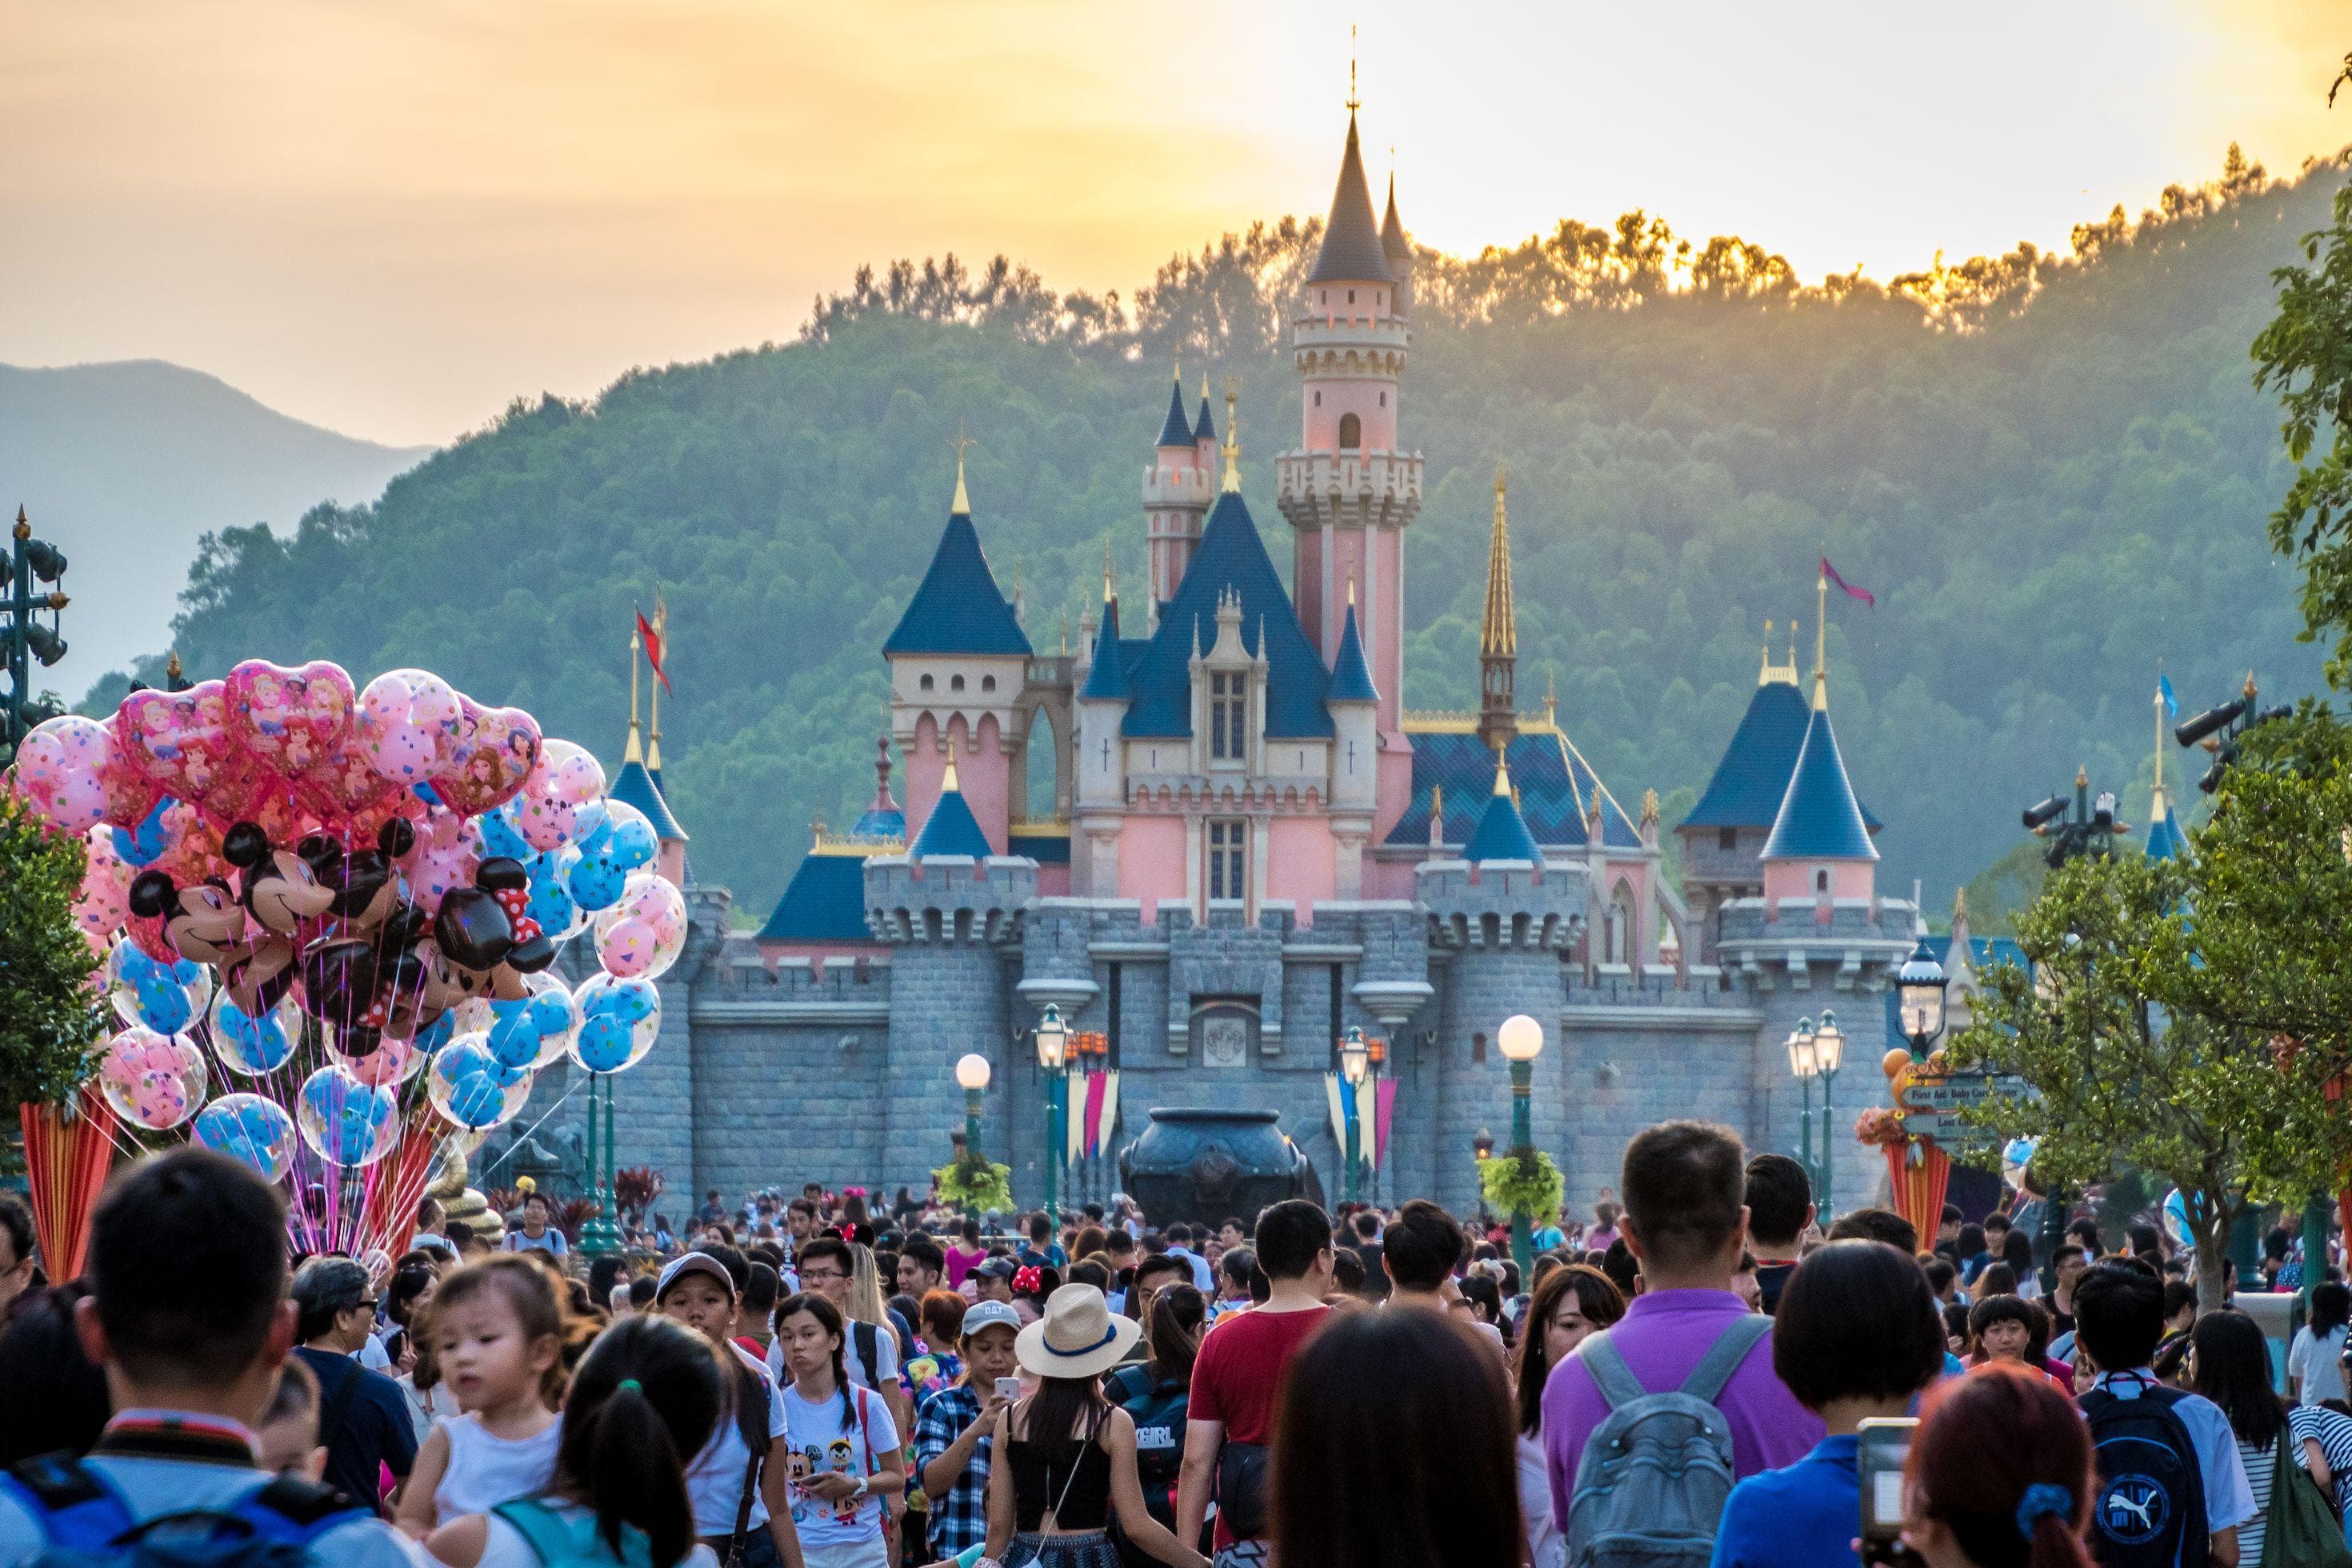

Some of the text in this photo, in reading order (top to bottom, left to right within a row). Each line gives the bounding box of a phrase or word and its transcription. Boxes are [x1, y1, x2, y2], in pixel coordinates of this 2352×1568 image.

[1912, 1090, 1930, 1099] First
[1938, 1117, 1954, 1127] Lost
[985, 1305, 1003, 1315] CAT
